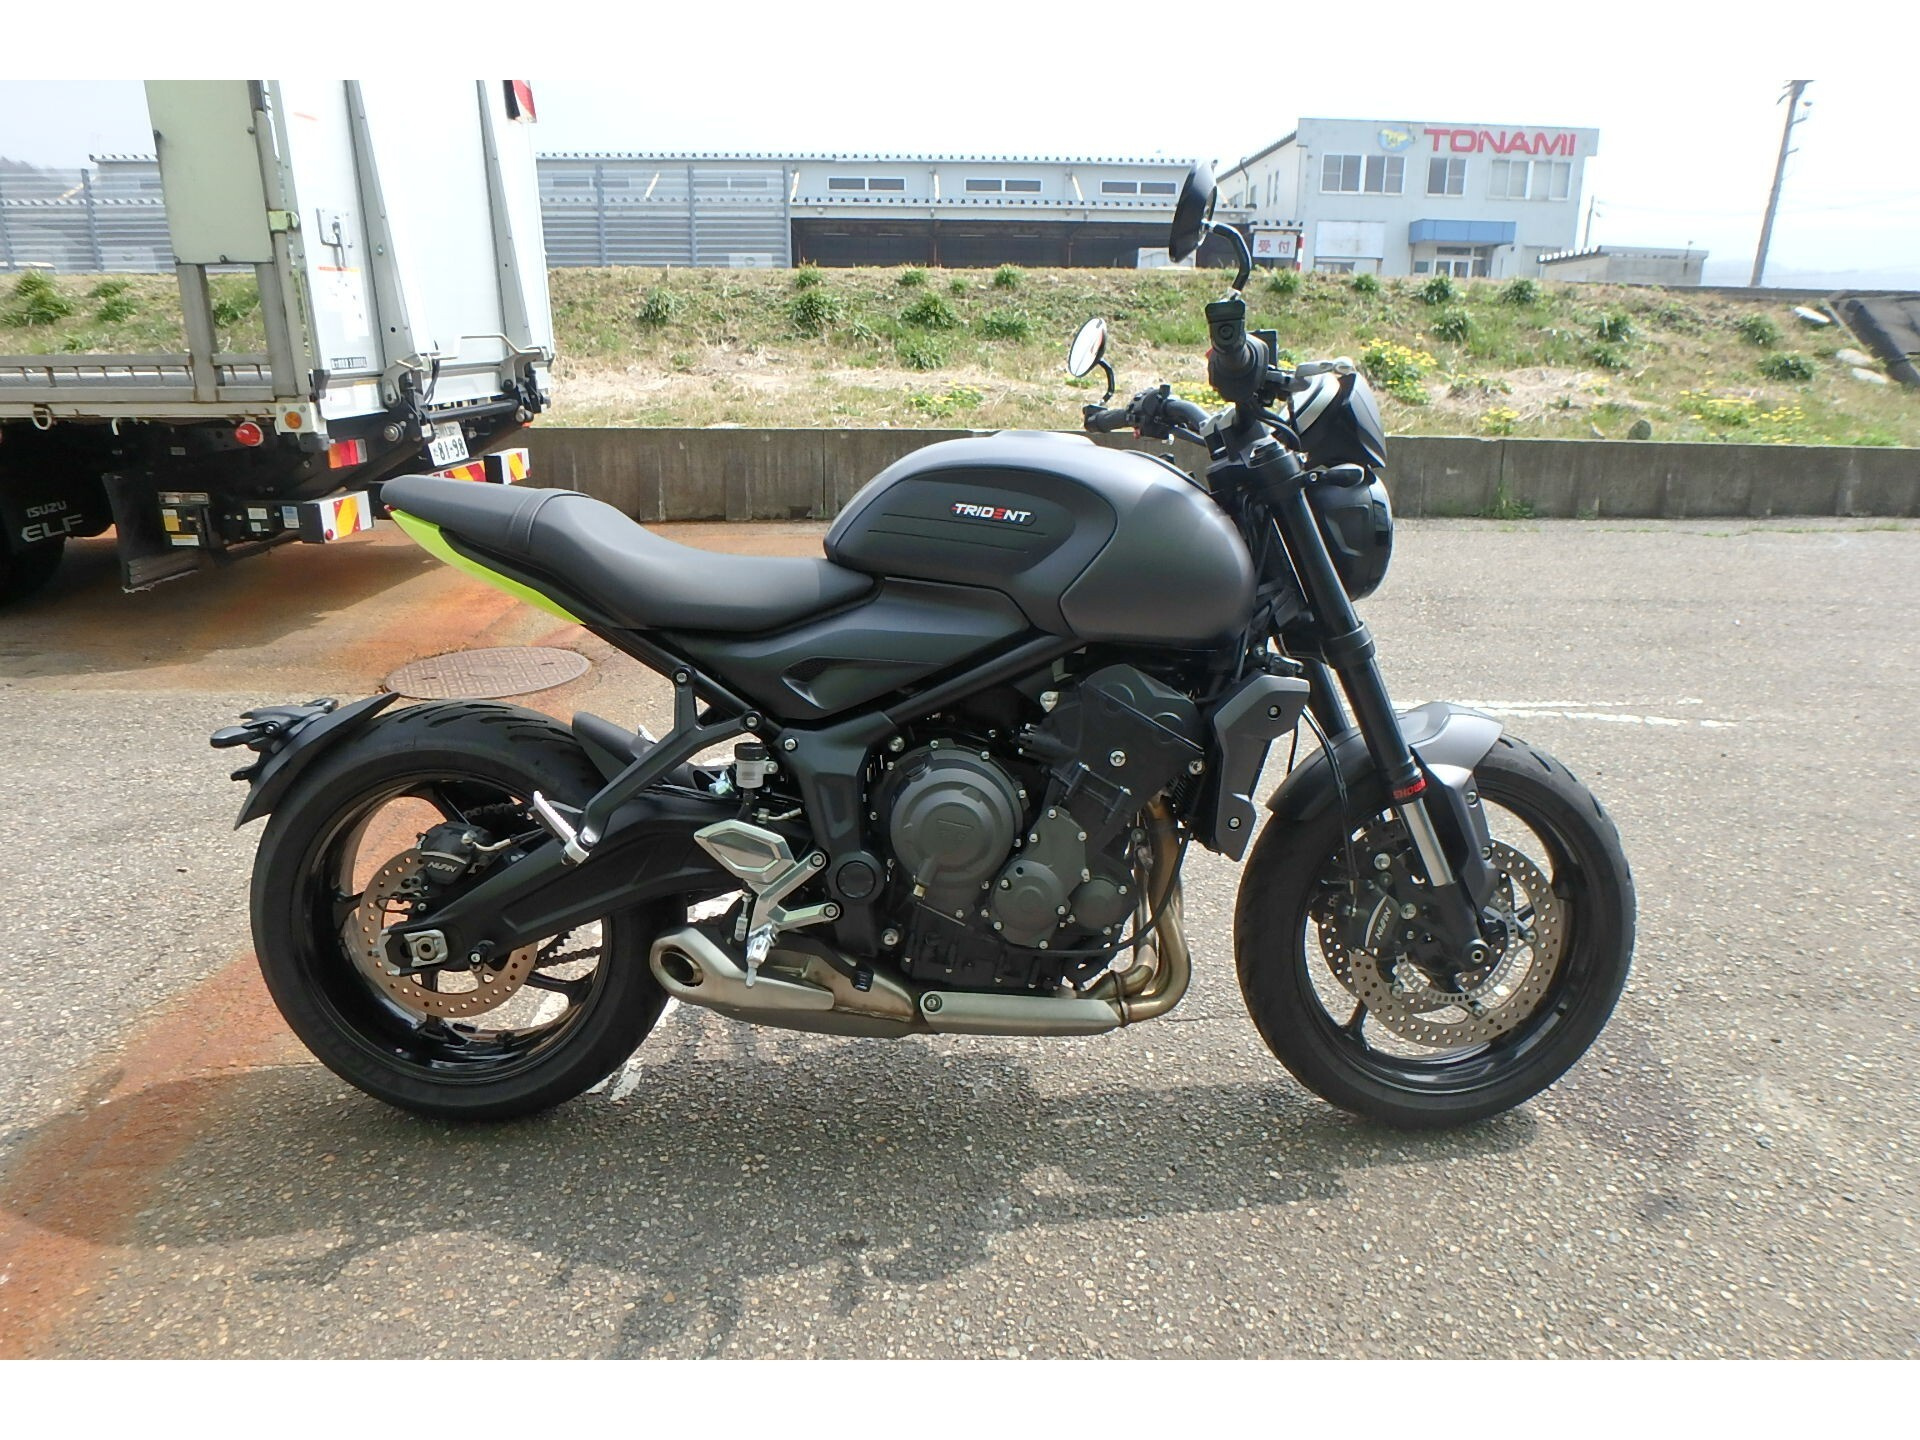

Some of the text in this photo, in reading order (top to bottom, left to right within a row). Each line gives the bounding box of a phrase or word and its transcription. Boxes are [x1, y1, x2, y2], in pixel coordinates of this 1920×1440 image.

[1424, 129, 1576, 156] TONAMI
[1258, 239, 1290, 254] 受付
[437, 438, 465, 460] 81-98
[26, 501, 66, 518] ISUZU
[952, 503, 1031, 522] TRIDENT
[21, 513, 83, 542] ELF
